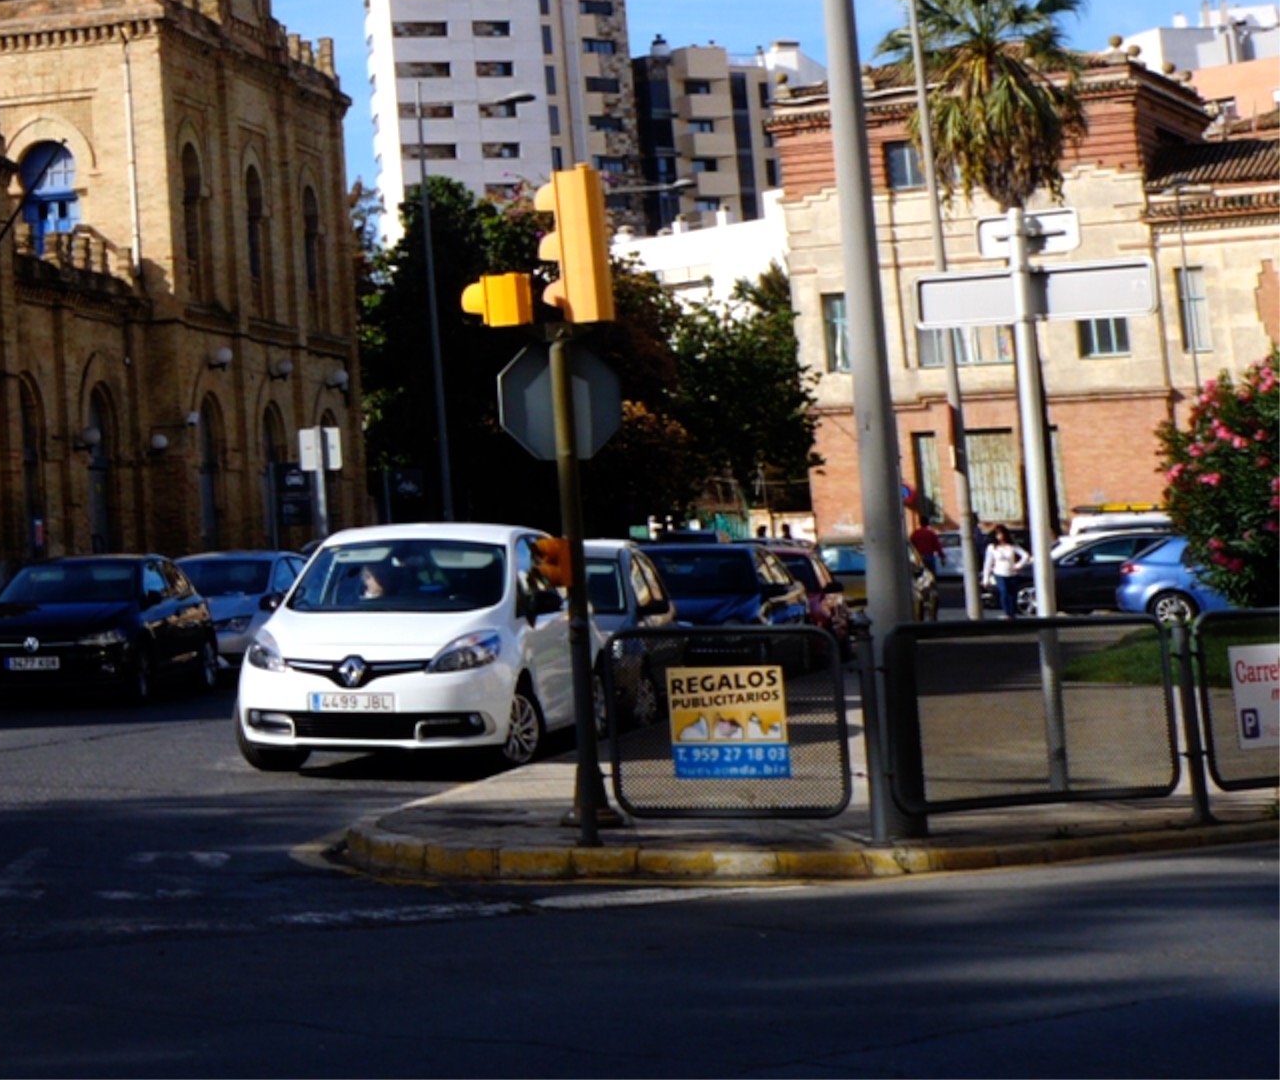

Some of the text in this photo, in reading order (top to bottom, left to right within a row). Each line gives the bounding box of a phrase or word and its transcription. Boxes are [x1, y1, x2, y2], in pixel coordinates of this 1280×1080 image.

[671, 670, 778, 696] REGALOS
[322, 695, 358, 710] 4499
[671, 689, 780, 710] PUBLICITARIOS
[677, 747, 787, 762] T. 959 27 18 03
